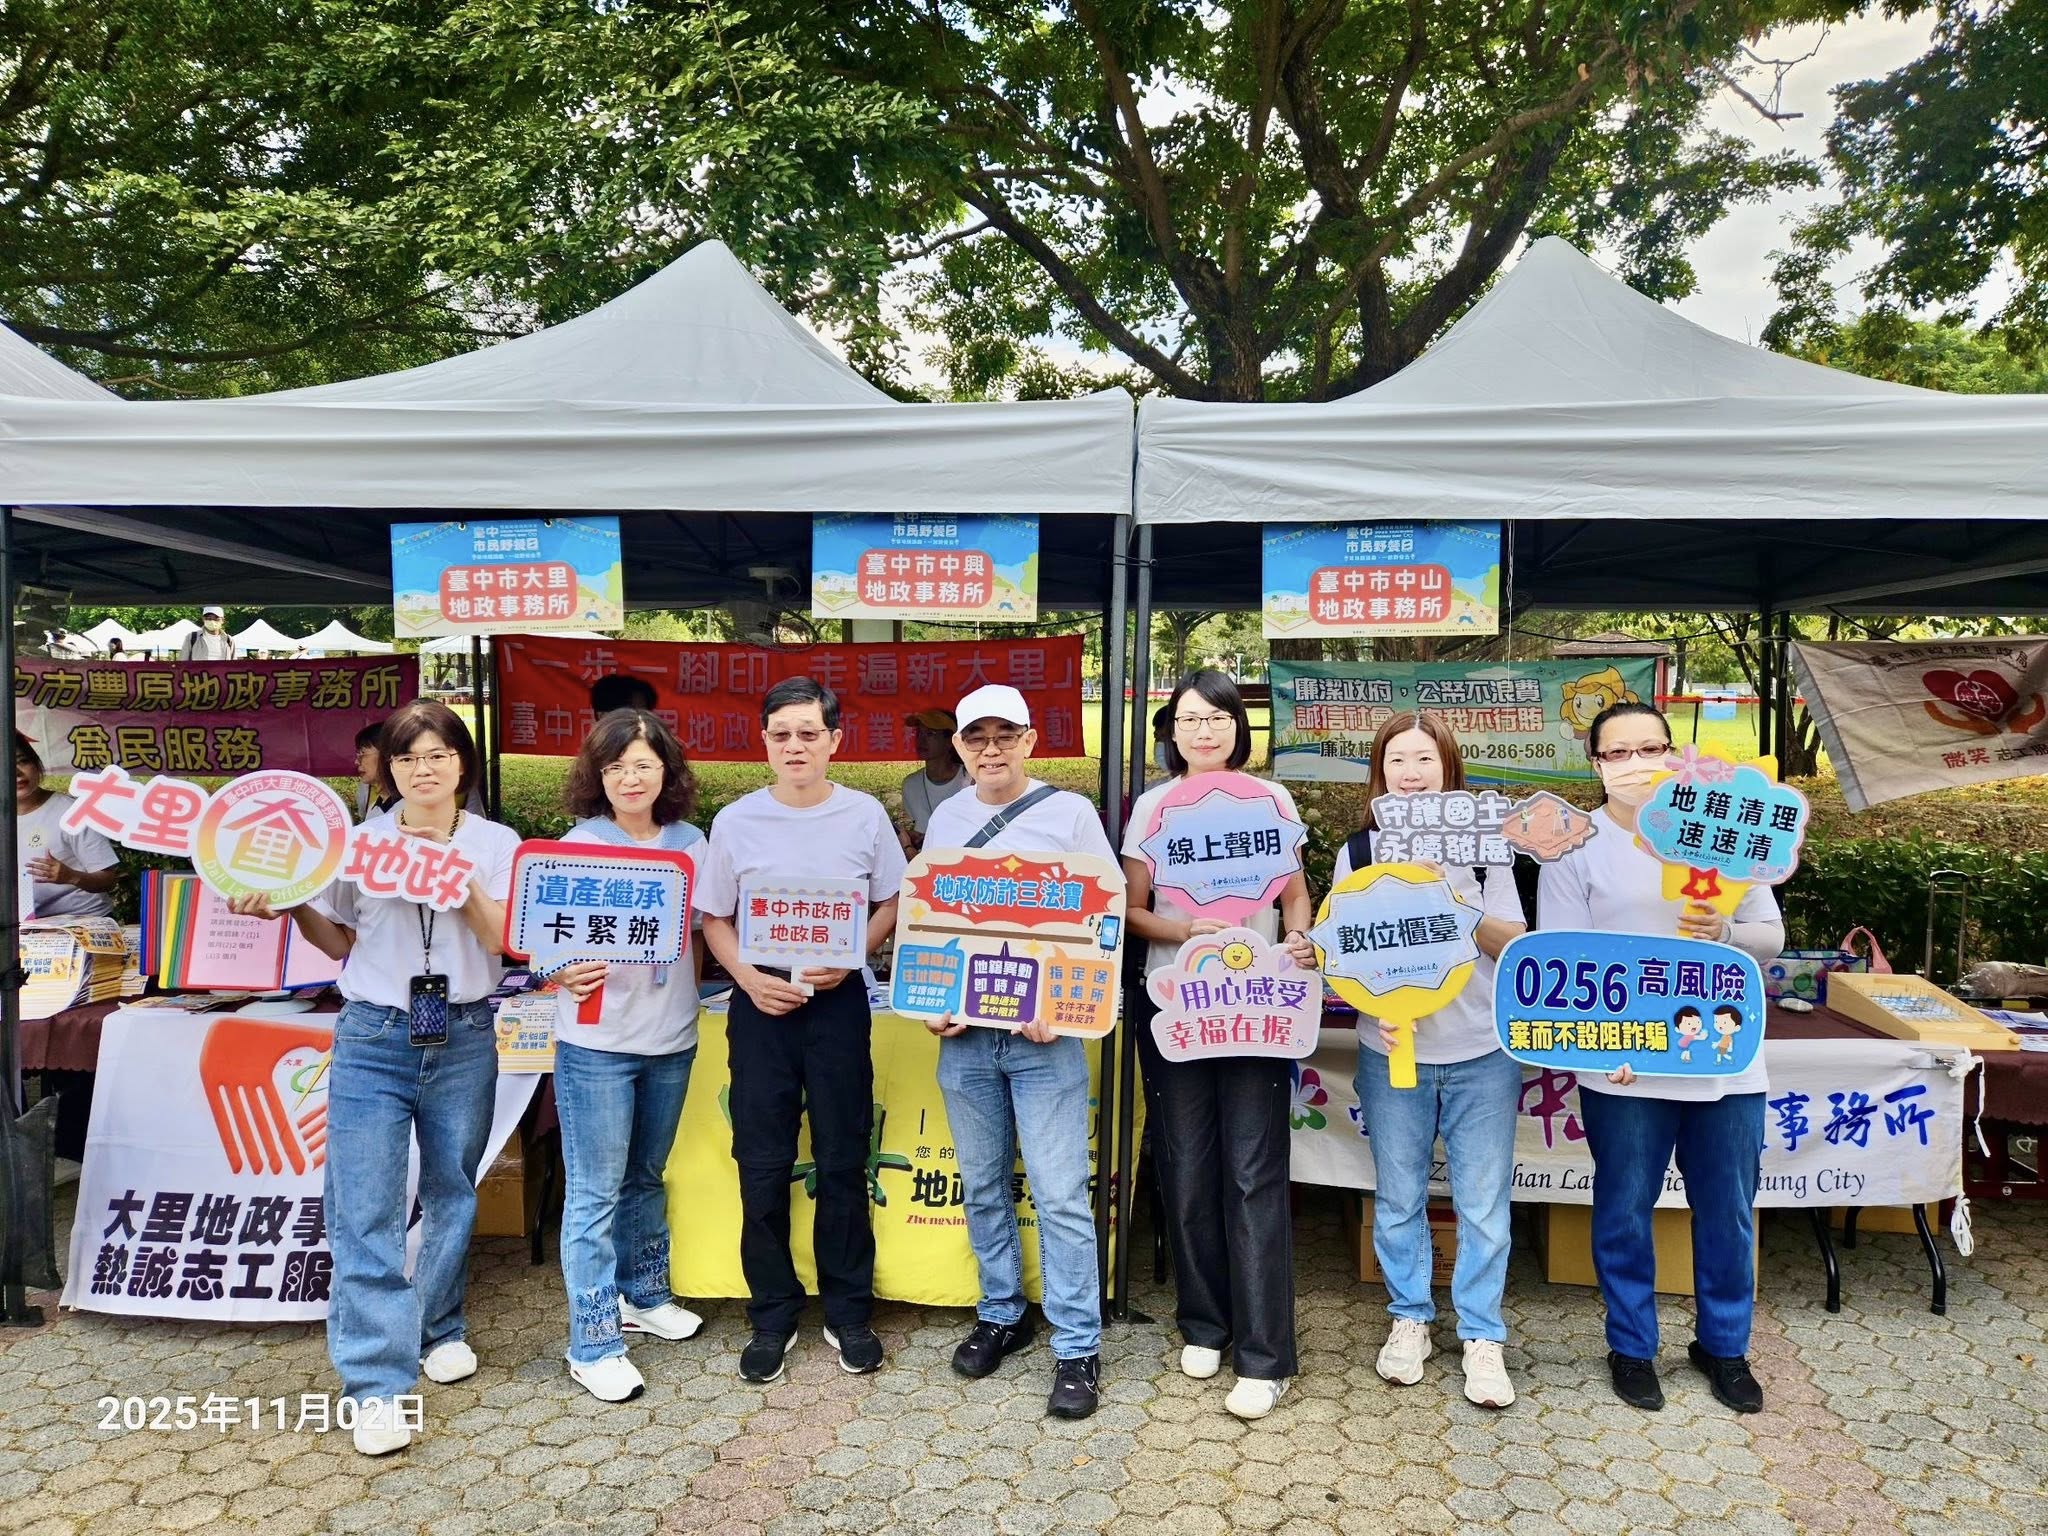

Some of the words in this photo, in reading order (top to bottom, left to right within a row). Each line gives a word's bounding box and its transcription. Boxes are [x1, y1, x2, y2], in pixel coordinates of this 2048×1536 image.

[447, 566, 569, 592] 臺中市大里
[865, 553, 985, 577] 臺中市中興
[865, 580, 985, 604] 地政事務所
[1317, 568, 1442, 593] 臺中市中山
[447, 593, 570, 619] 地政事務所
[1317, 597, 1443, 621] 地政事務所
[66, 772, 202, 851] 大里
[1378, 796, 1508, 827] 守護國土
[1669, 783, 1799, 834] 地籍清理
[1166, 828, 1282, 867] 線上聲明
[1380, 834, 1511, 863] 永續發展
[1676, 819, 1774, 863] 速速清
[344, 831, 475, 908] 地政
[535, 873, 667, 911] 遺產繼承
[933, 874, 1084, 912] 地政防詐三法寶
[750, 897, 852, 920] 臺中市政府
[543, 912, 660, 946] 卡緊辦
[769, 923, 829, 944] 地政局
[1336, 912, 1461, 955] 數位櫃臺
[973, 959, 1033, 980] 地籍異動
[1050, 966, 1109, 985] 指定送
[1515, 956, 1629, 1013] 0256
[1636, 957, 1746, 1002] 高風險
[973, 977, 1029, 997] 即時通
[1049, 984, 1105, 1004] 達處所
[1179, 977, 1309, 1013] 用心感受
[1055, 1001, 1097, 1014] 文件不漏
[1166, 1013, 1295, 1051] 幸福在握
[1508, 1020, 1669, 1053] 棄而不設阻詐騙
[1816, 1168, 1866, 1198] City
[90, 1243, 333, 1303] 熱誠志工服
